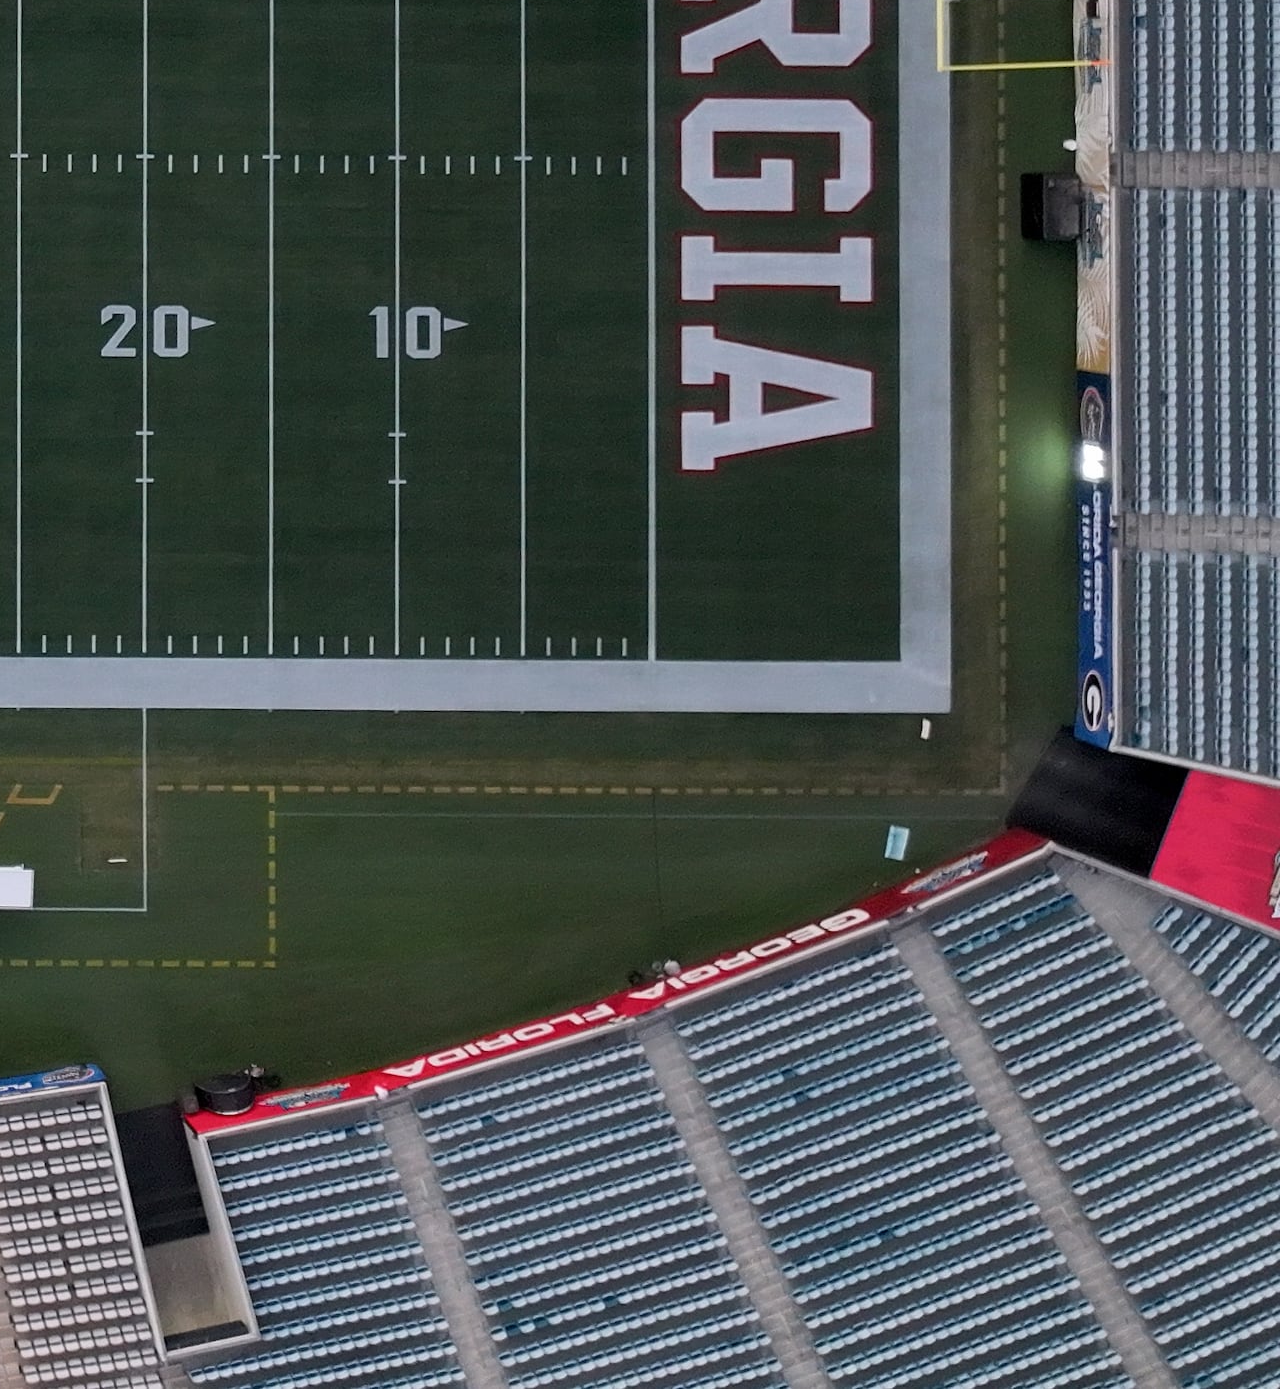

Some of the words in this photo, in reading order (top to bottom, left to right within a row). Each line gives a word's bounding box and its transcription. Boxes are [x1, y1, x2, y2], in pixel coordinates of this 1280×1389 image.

[101, 305, 189, 358] 20
[369, 306, 442, 359] 10
[1081, 504, 1091, 562] SINCE
[1093, 484, 1103, 558] ORIDA
[1093, 560, 1103, 660] GEORGIA
[627, 908, 871, 1000] GEORGIA
[382, 1002, 617, 1078] FLORIDA
